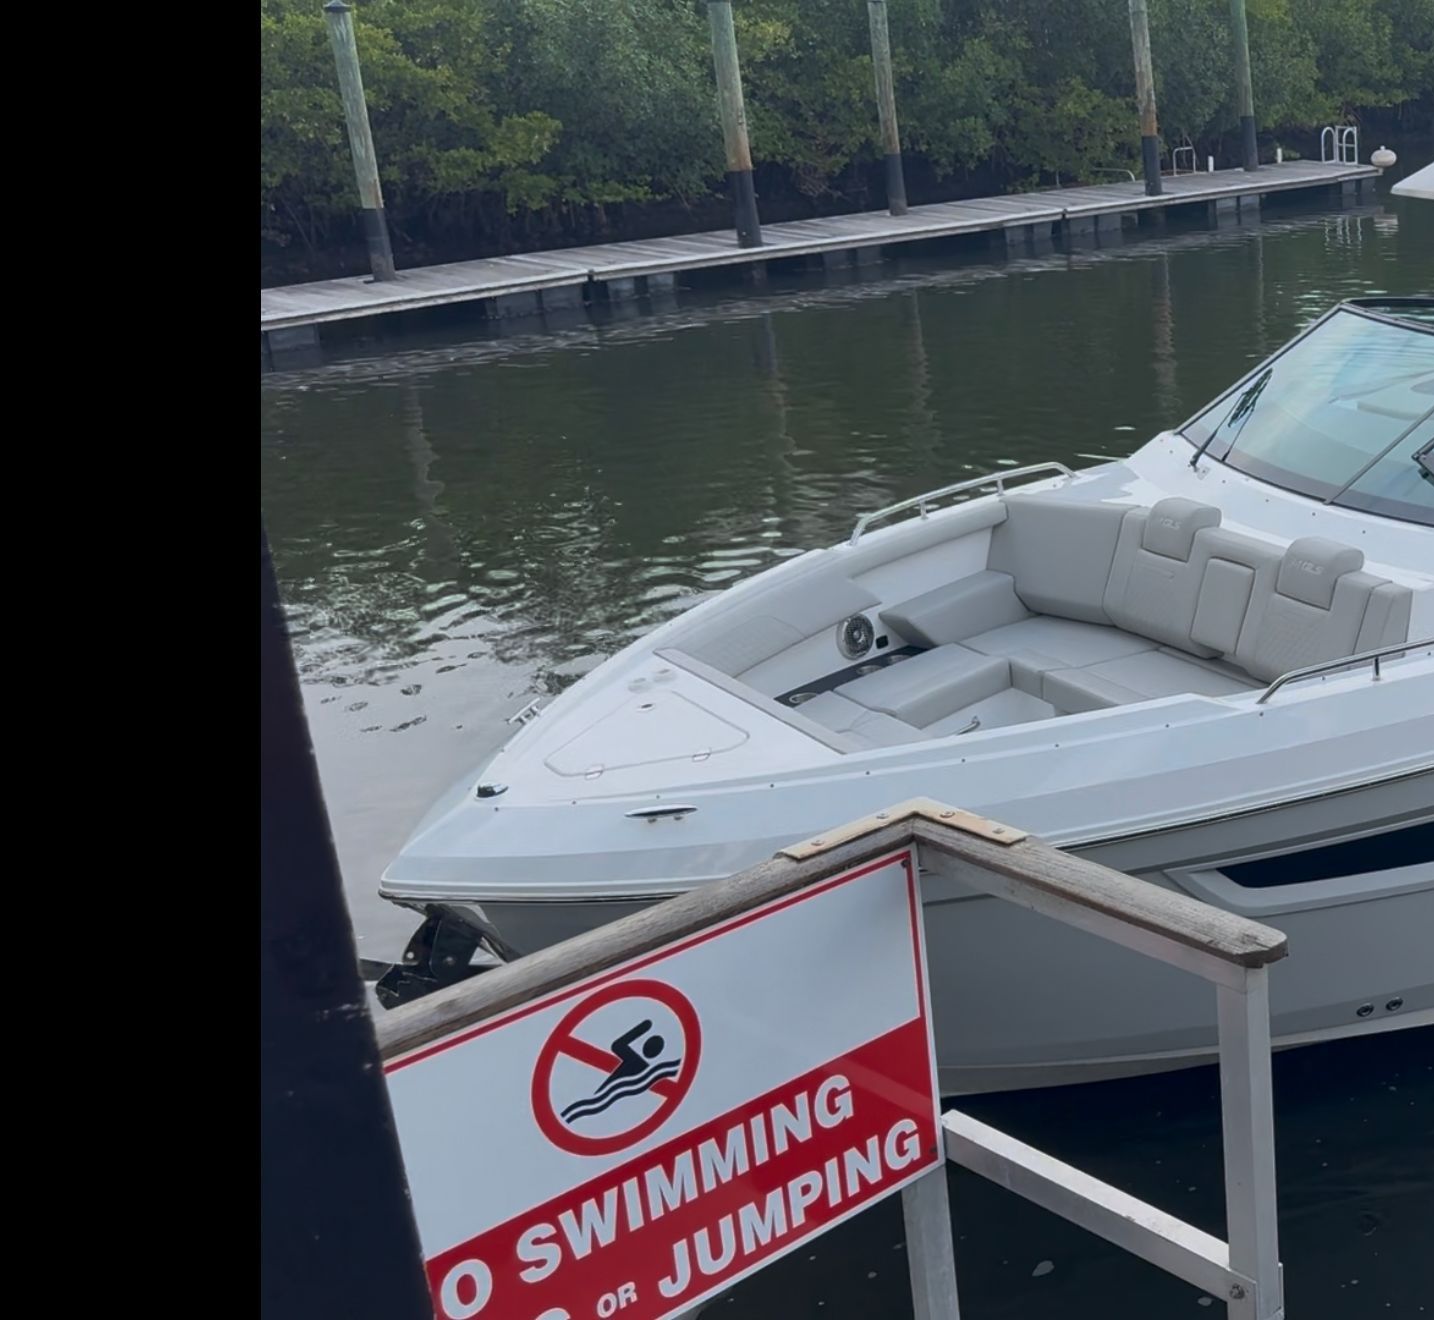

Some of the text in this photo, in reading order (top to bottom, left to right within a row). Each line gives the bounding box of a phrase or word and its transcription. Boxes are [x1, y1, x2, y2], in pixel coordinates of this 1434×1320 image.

[439, 1074, 855, 1320] O SWIMMING
[597, 1118, 921, 1318] OR JUMPING
